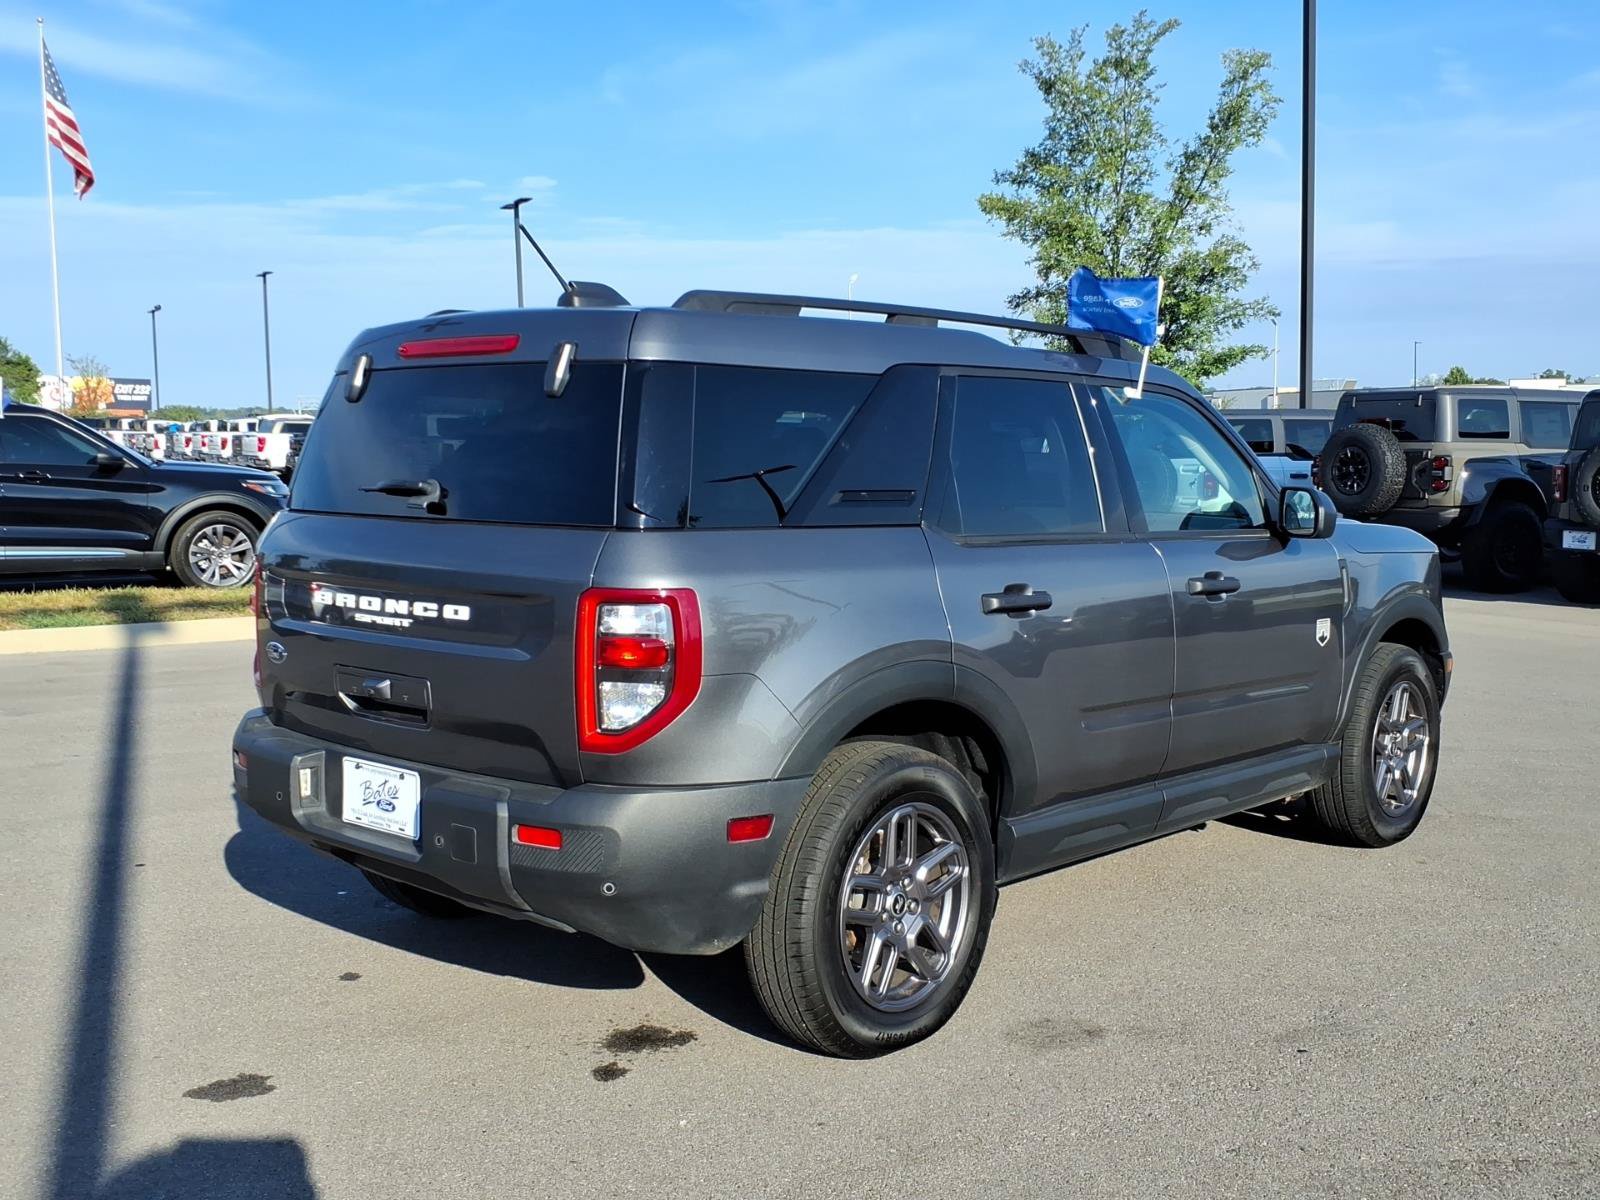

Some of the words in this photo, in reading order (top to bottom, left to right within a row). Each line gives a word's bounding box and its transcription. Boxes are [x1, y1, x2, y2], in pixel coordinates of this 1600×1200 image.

[114, 384, 134, 395] EXIT
[314, 591, 470, 621] BRONCO
[354, 613, 414, 627] SPORT
[360, 779, 400, 801] Bates
